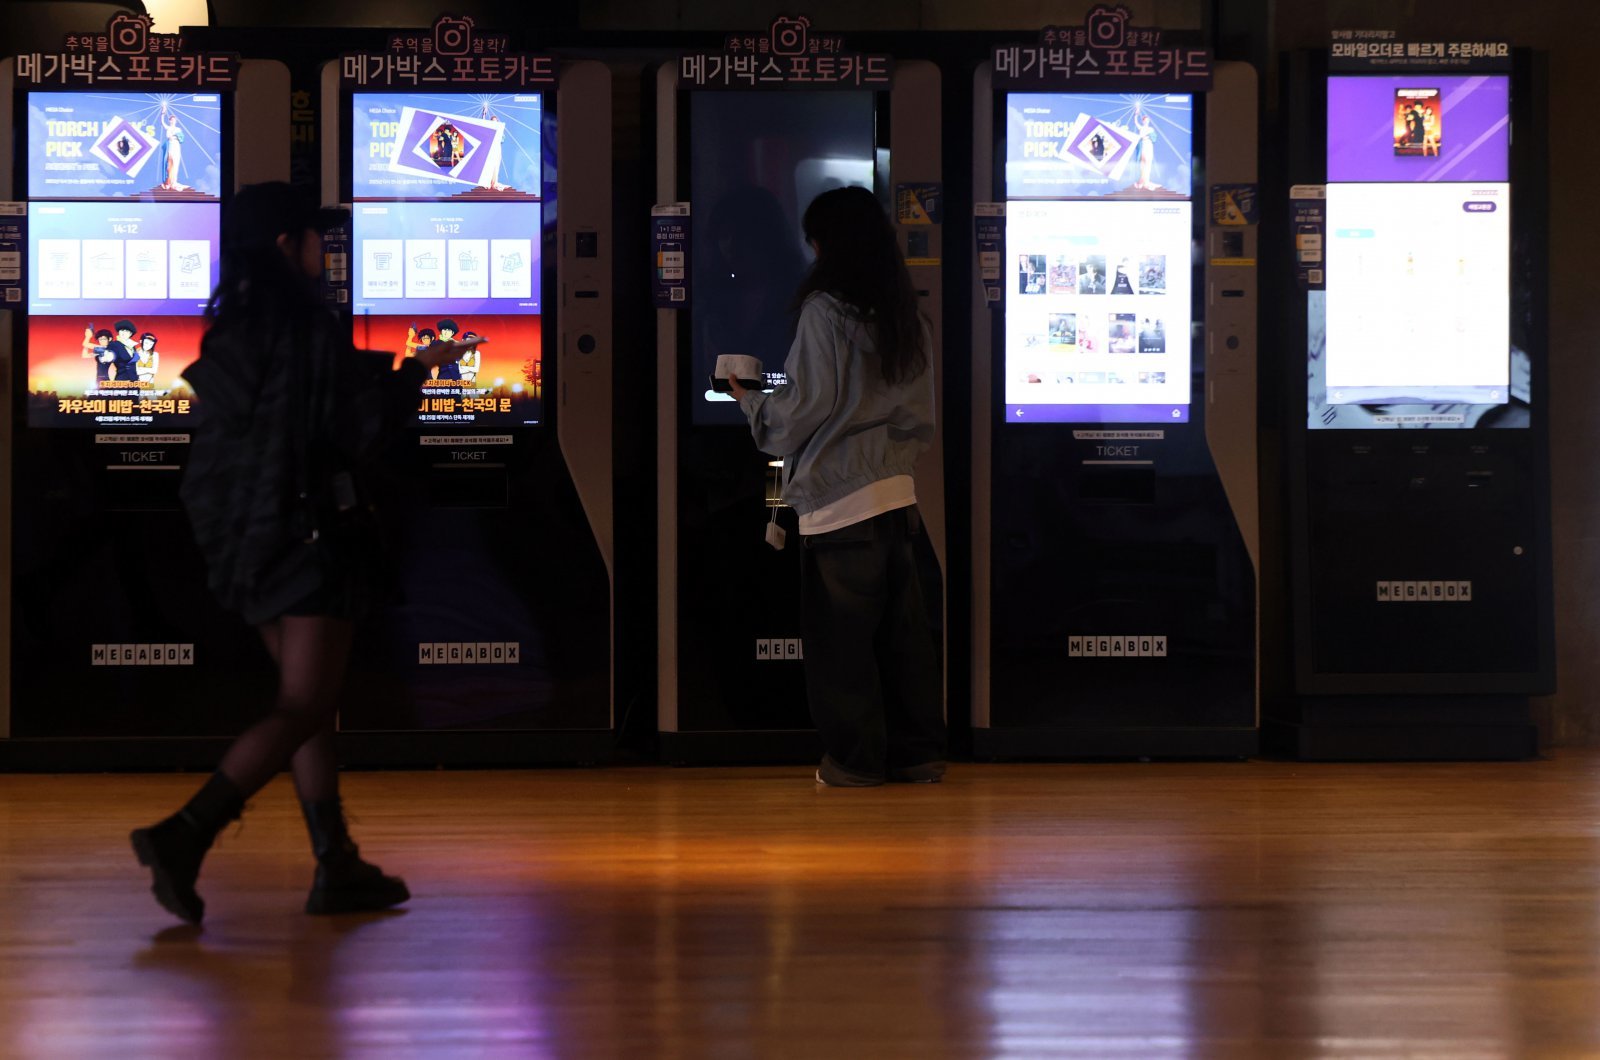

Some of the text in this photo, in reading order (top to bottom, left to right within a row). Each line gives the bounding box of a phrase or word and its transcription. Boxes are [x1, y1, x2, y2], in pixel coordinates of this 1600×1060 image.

[66, 36, 182, 52] 추억을 찰칵!
[392, 38, 506, 52] 추억을 찰칵!
[730, 38, 841, 52] 추억을 찰칵!
[1332, 42, 1508, 57] 모바일오더로 빠르게 주문하세요
[18, 54, 232, 85] 메가박스 포토카드
[344, 55, 554, 85] 메가박스 포토카드
[682, 55, 888, 85] 메가박스 포토카드
[996, 48, 1208, 80] 메가박스 포토카드
[46, 121, 98, 137] TORCH
[370, 122, 400, 138] TOR
[46, 142, 83, 157] PICK
[370, 142, 396, 158] PIC
[1024, 142, 1059, 158] PICK
[112, 224, 138, 234] 14:12
[436, 224, 460, 234] 14:12
[58, 400, 190, 414] 카우보이 비밥-천국의 문
[432, 398, 496, 412] 비밥-천국의
[500, 398, 511, 412] 문
[120, 451, 166, 462] TICKET
[452, 452, 487, 460] TICKET
[1096, 446, 1139, 456] TICKET
[1378, 584, 1470, 598] MEGABOX
[420, 645, 517, 661] MEGABOX
[1070, 639, 1165, 654] MEGABOX
[93, 647, 192, 662] MEGABOX
